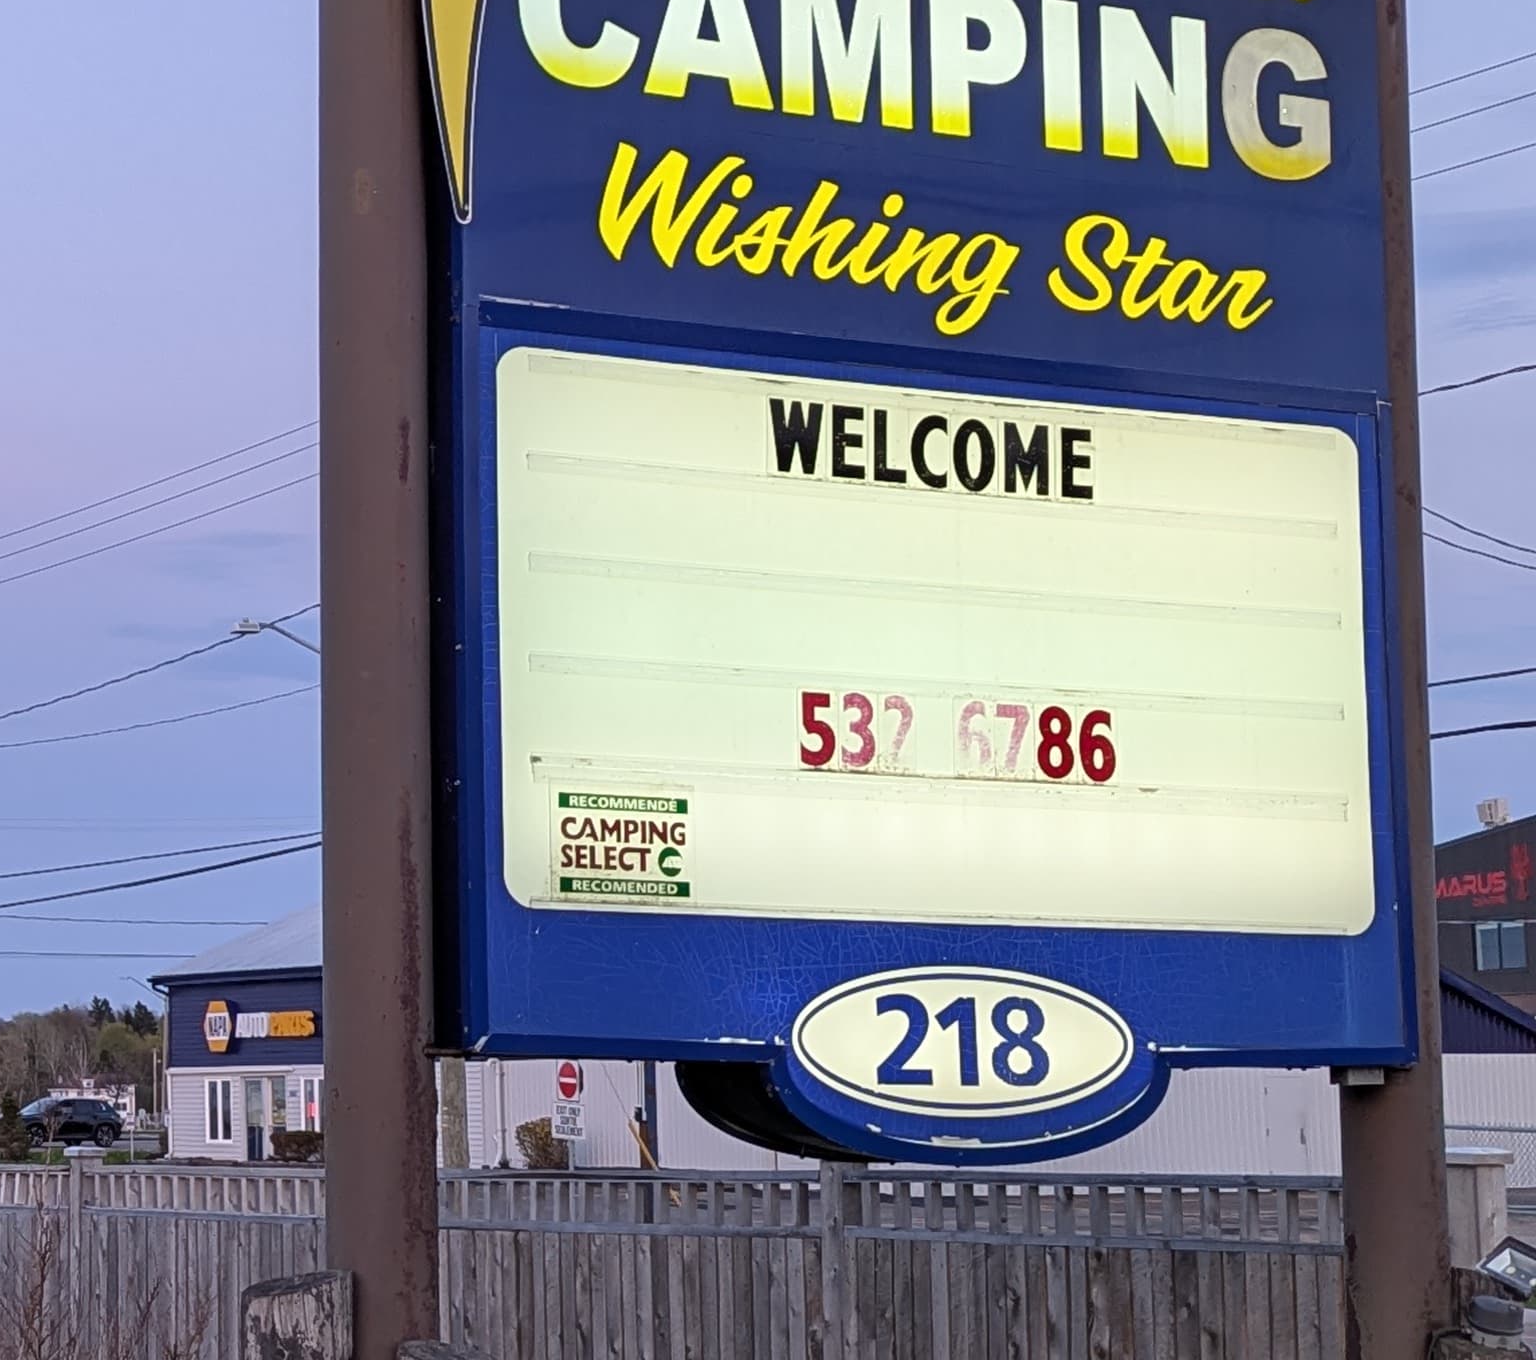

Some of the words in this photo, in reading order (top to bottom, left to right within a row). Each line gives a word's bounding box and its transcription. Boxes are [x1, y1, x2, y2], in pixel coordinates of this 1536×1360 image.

[597, 142, 1021, 336] Wishing
[1048, 215, 1274, 330] Star
[768, 397, 1094, 500] WELCOME
[958, 699, 1117, 783] 6786
[560, 816, 686, 846] CAMPING
[560, 843, 652, 872] SELECT
[571, 879, 679, 895] RECOMENDED
[235, 1013, 269, 1038] AUTO
[270, 1011, 315, 1036] PARTS
[876, 993, 1050, 1087] 218
